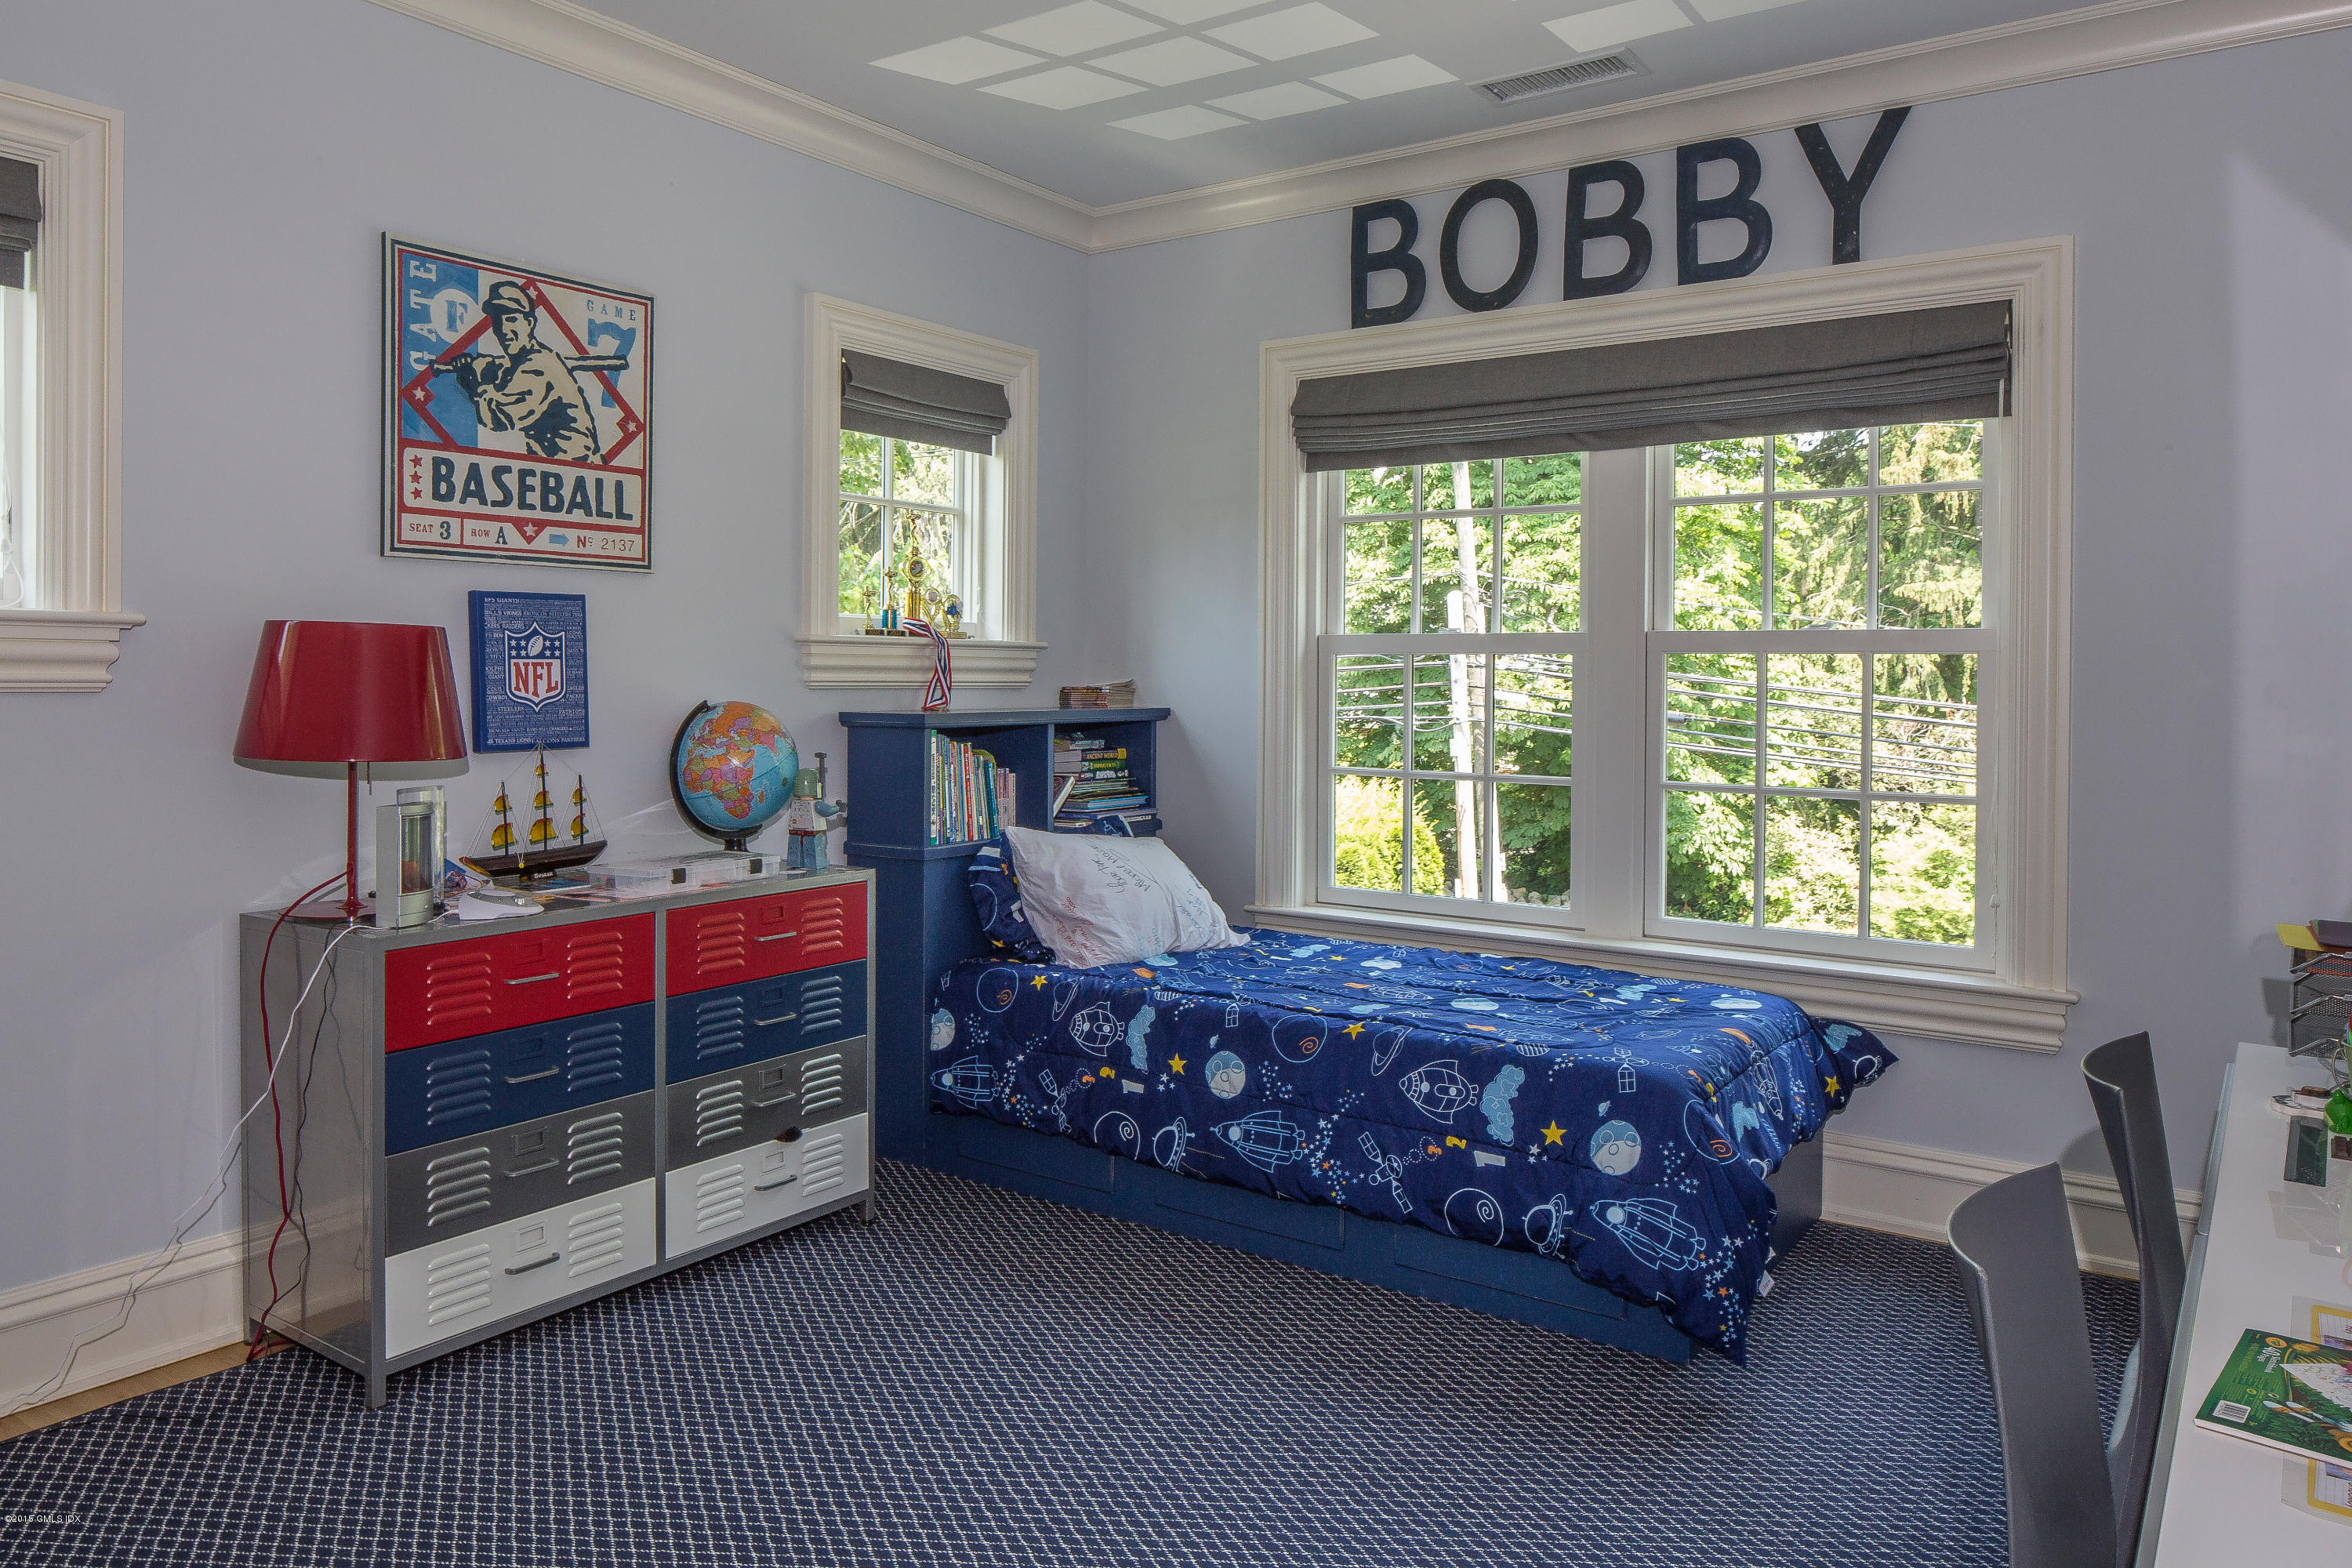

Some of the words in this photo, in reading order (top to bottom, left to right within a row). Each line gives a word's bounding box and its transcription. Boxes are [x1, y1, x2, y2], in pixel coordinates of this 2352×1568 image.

[1351, 104, 1912, 329] BOBBY
[410, 260, 437, 371] GATE
[587, 299, 636, 321] GAME
[588, 318, 637, 408] 7
[431, 456, 633, 521] BASEBALL
[409, 523, 433, 533] SEAT
[440, 521, 452, 540] 3
[471, 528, 490, 538] ROW
[495, 526, 508, 545] A
[601, 538, 634, 552] 2137
[513, 661, 559, 698] NFL
